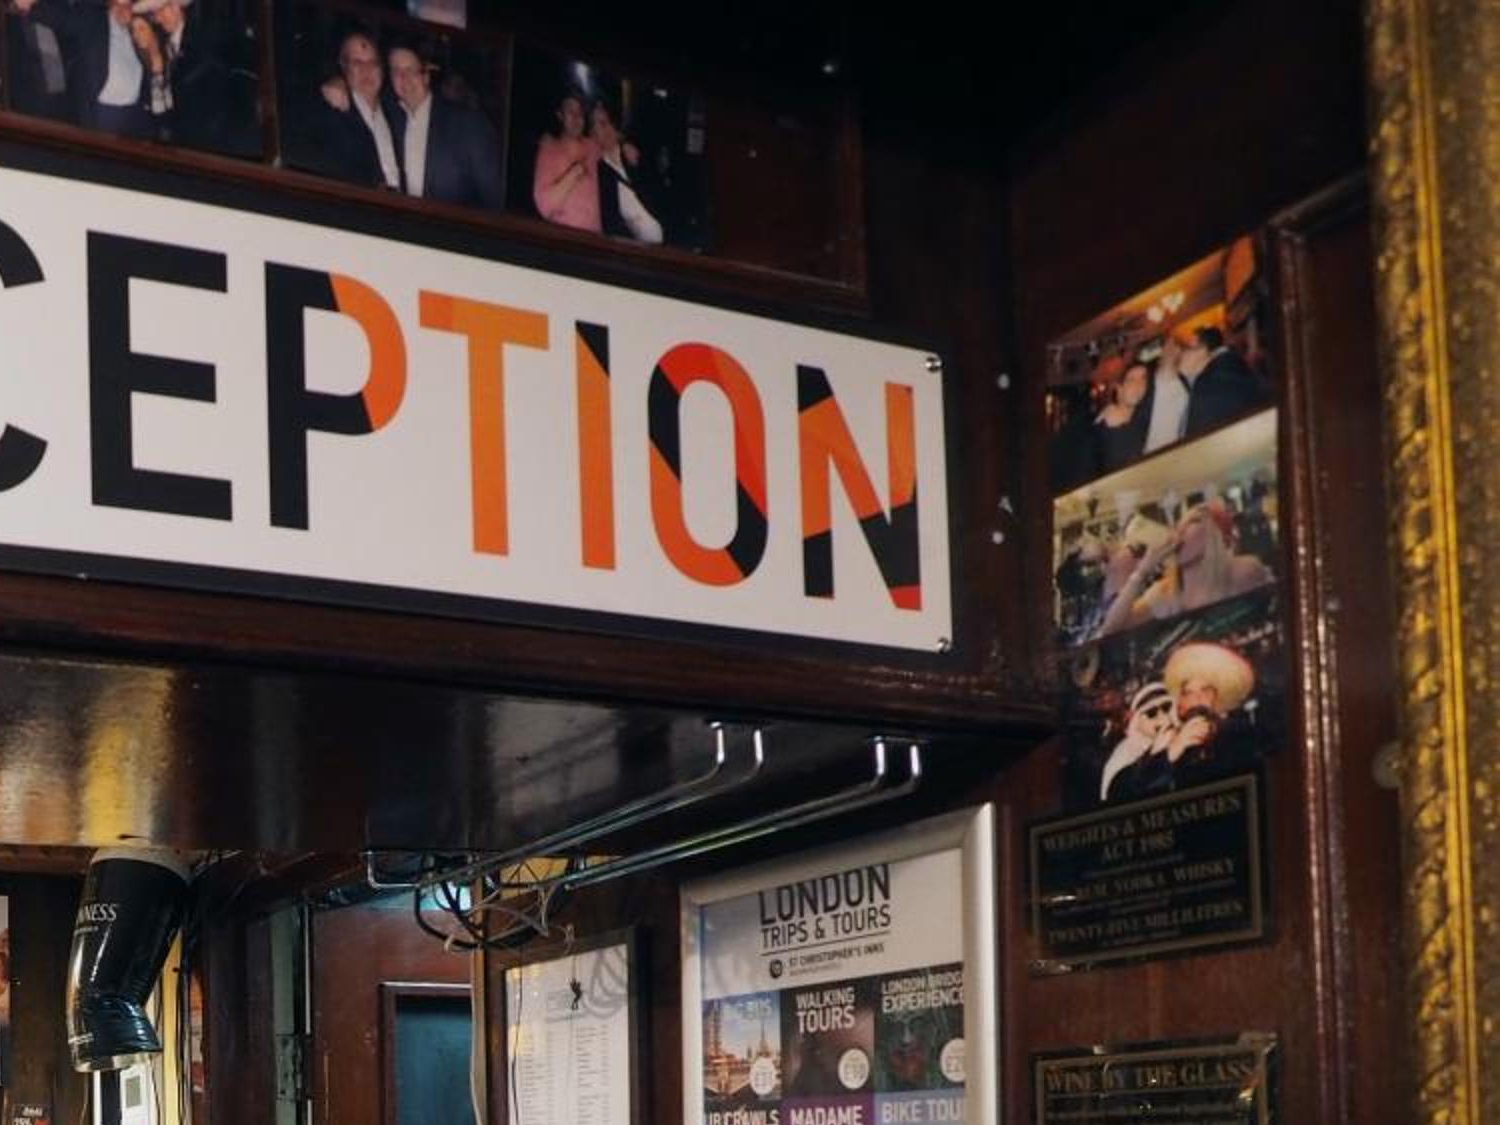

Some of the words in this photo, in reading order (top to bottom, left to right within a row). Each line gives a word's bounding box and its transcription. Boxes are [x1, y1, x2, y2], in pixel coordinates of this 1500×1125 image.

[758, 864, 891, 926] LONDON
[760, 919, 808, 949] TRIPS
[814, 916, 826, 939] &
[832, 904, 891, 935] TOURS
[796, 986, 855, 1009] WALKING
[798, 1005, 855, 1033] TOURS
[1045, 1070, 1092, 1093] WINE
[881, 1100, 924, 1124] BIKE
[927, 1098, 965, 1121] TOU
